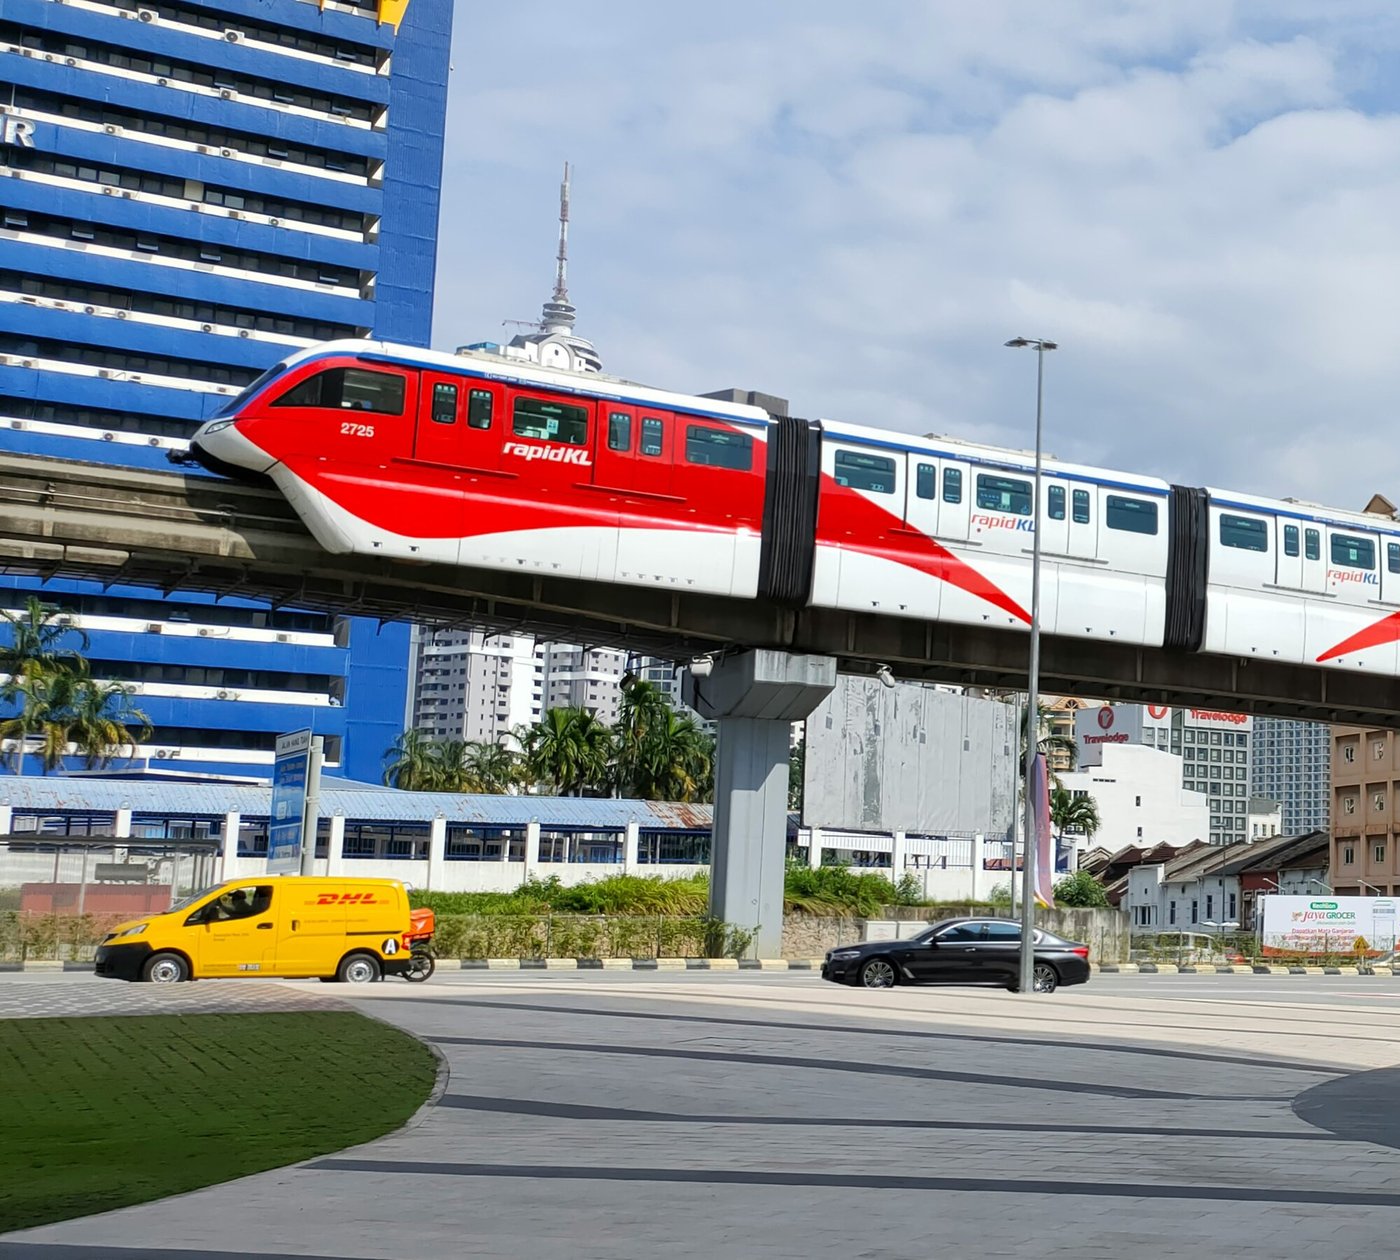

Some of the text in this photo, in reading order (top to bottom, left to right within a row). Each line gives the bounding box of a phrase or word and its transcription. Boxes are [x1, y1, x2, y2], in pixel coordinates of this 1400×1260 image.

[340, 422, 375, 437] 2725
[502, 442, 592, 465] rapidKL
[971, 514, 1036, 532] rapidKL
[1327, 569, 1379, 585] rapidKL
[1083, 732, 1130, 744] Travelodge
[317, 893, 377, 905] DHL
[1326, 911, 1356, 919] GROCER
[384, 938, 397, 954] A
